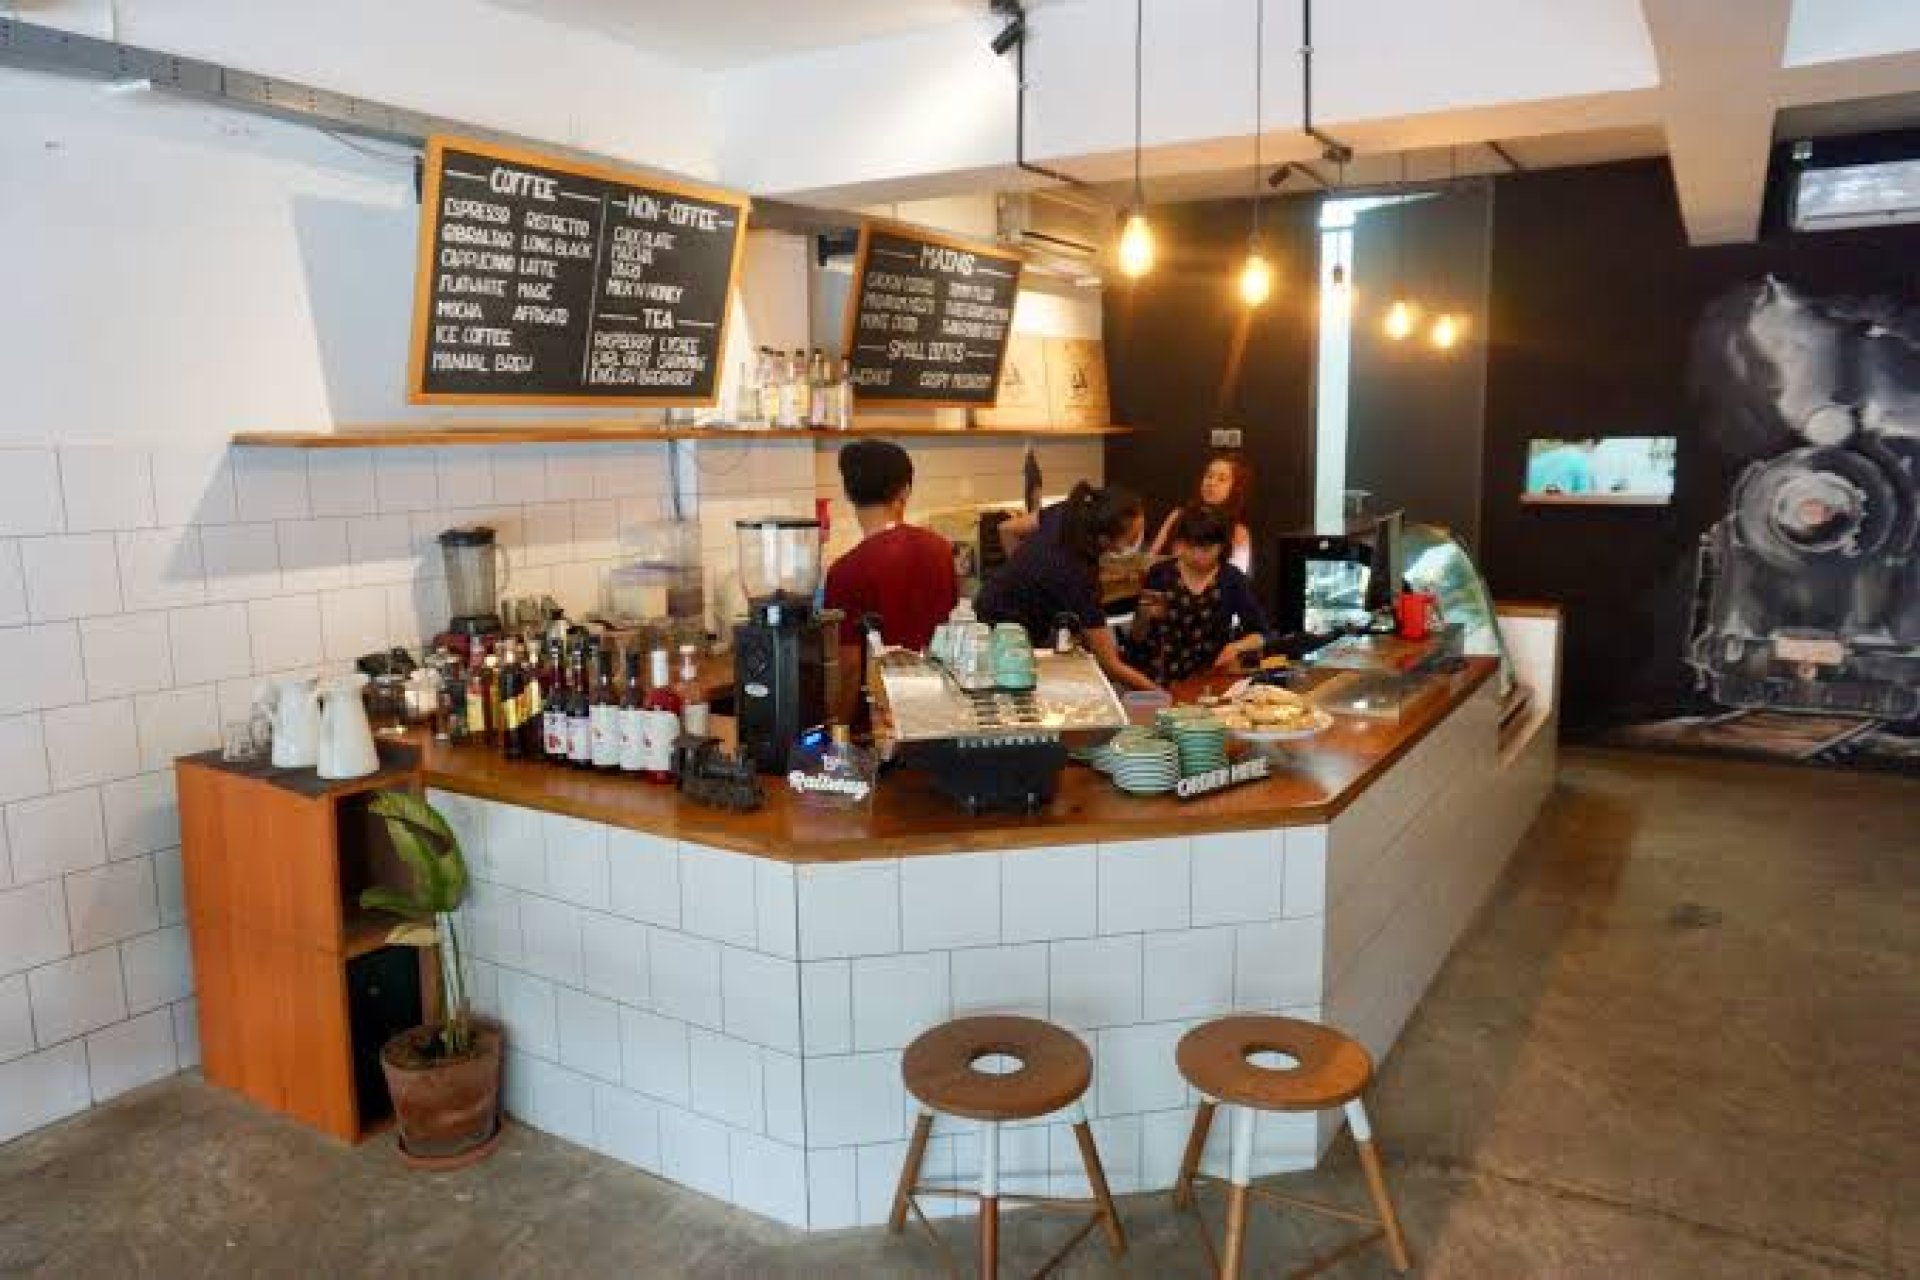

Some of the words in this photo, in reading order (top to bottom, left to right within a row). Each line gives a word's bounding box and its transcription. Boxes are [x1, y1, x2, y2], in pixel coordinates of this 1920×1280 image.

[491, 168, 558, 201] COFFEE
[444, 198, 510, 224] ESPRESSO
[520, 257, 558, 279] LATTE
[436, 300, 483, 320] MOCHA
[643, 308, 674, 330] TEA
[435, 325, 459, 344] ICE
[461, 327, 513, 346] COFFEE
[432, 350, 490, 371] MANUAL
[494, 354, 533, 372] BREW
